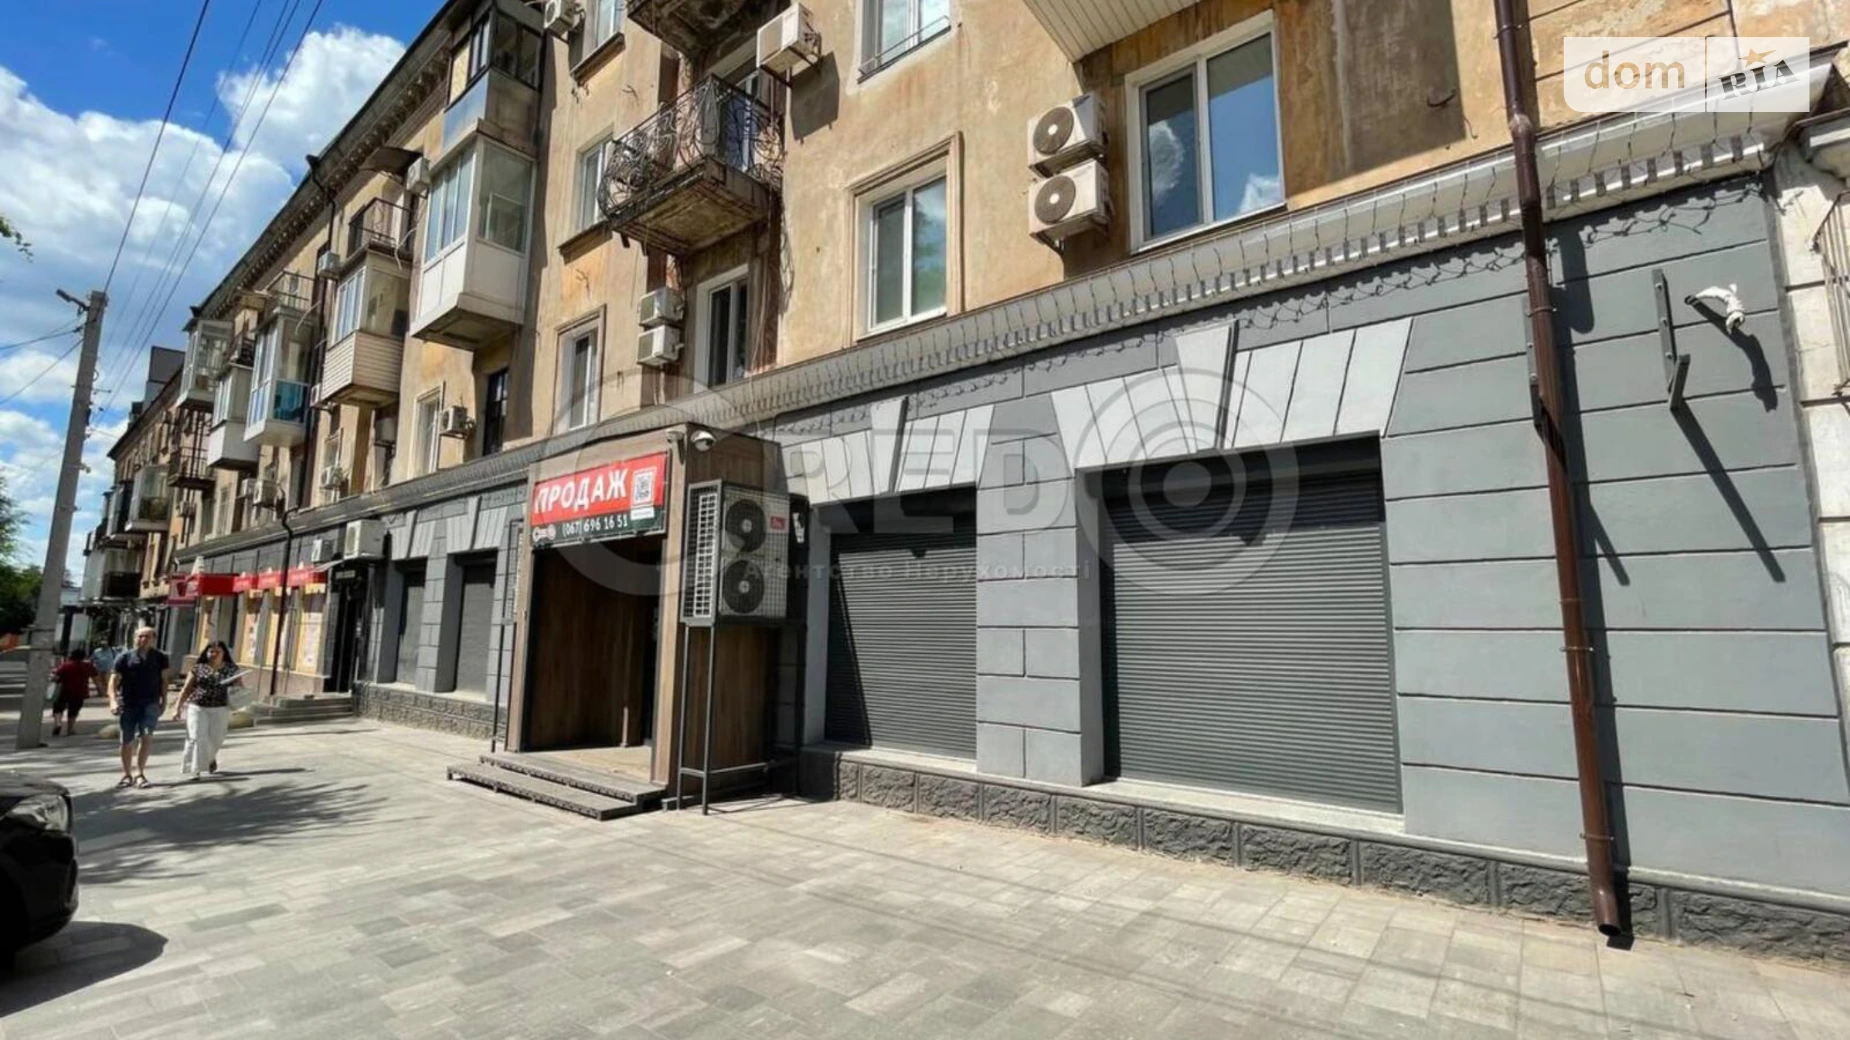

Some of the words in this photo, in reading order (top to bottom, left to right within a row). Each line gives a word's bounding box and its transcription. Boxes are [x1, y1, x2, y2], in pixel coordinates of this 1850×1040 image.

[534, 467, 629, 514] ПРОДАЖ
[562, 518, 583, 538] (067)
[583, 518, 602, 533] 696
[603, 515, 615, 530] 16
[617, 513, 629, 528] 51
